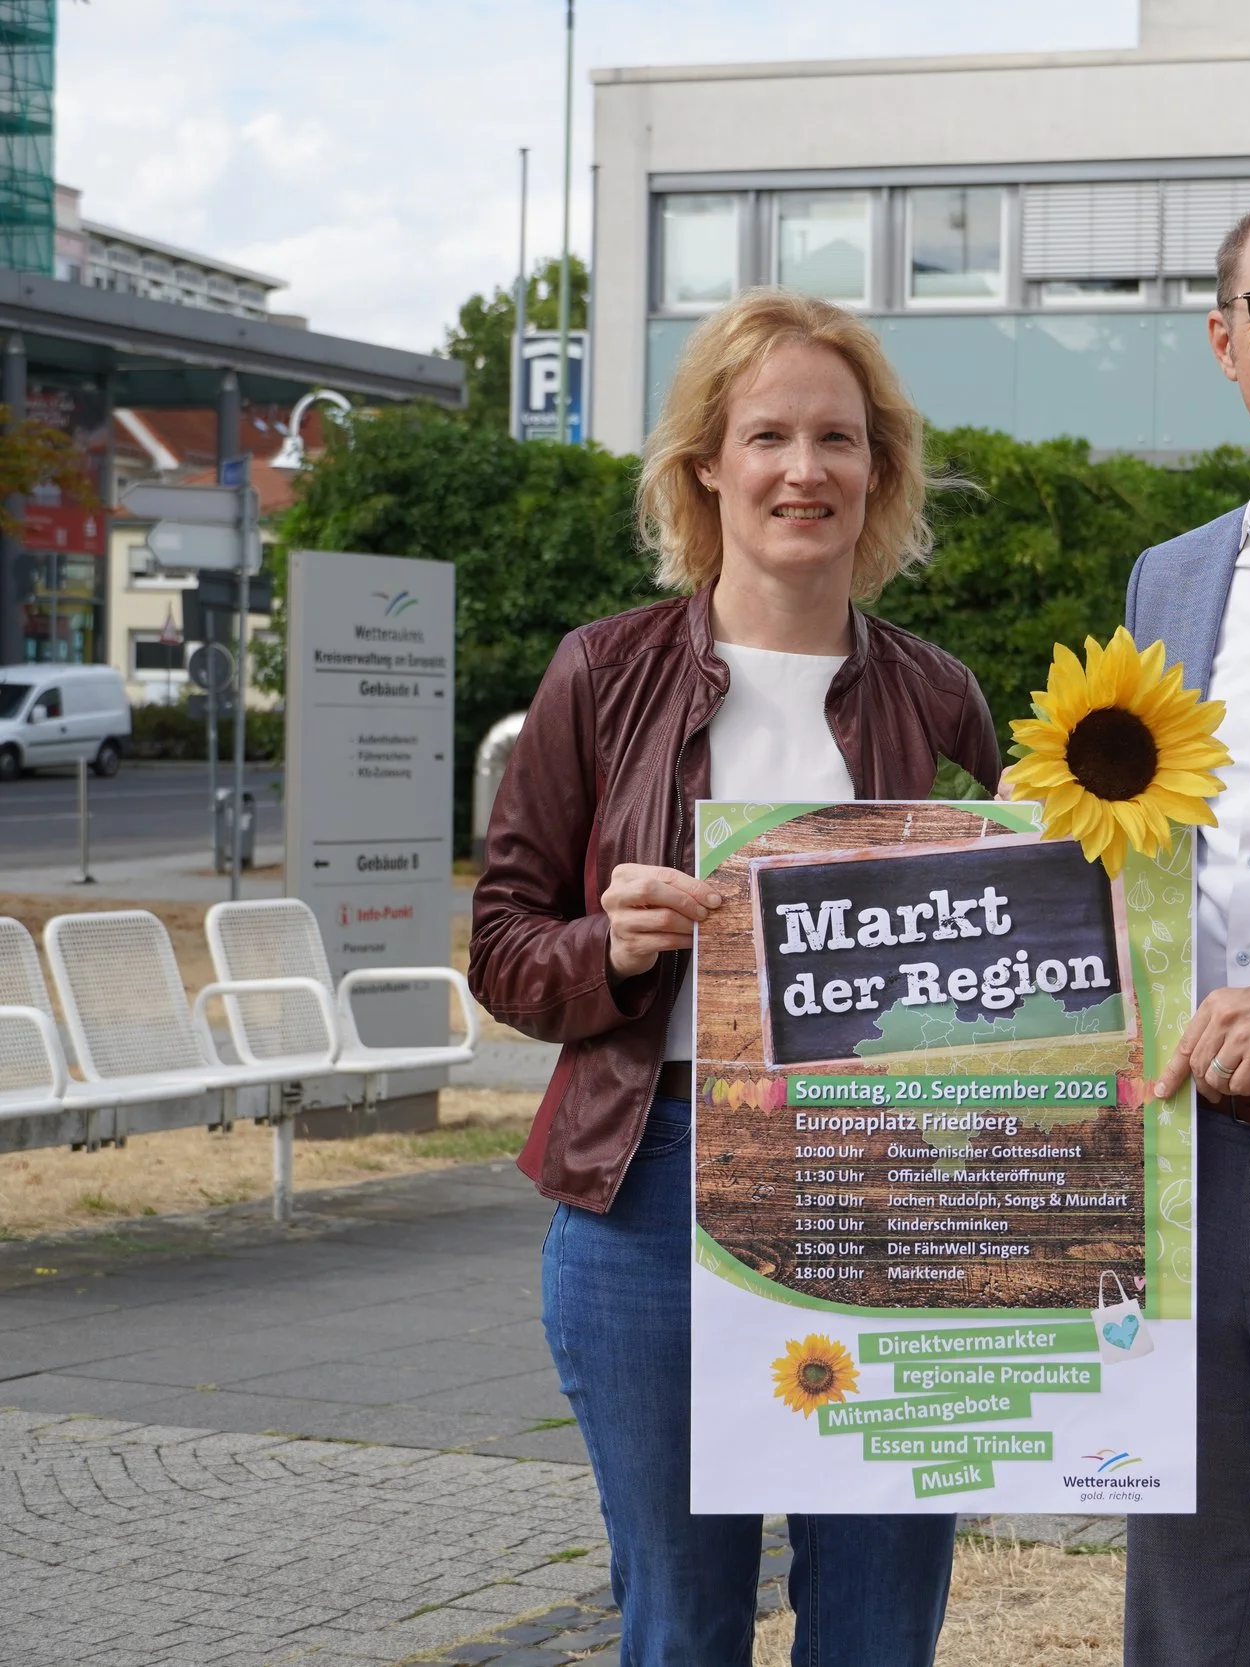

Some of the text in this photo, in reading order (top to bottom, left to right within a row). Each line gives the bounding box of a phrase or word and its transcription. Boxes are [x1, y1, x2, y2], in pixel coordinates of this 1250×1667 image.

[357, 856, 408, 871] Gebäude
[776, 886, 1011, 954] Markt
[784, 950, 1111, 1016] der Region
[796, 1081, 1107, 1104] Sonntag, 20. September 2026
[796, 1113, 1017, 1136] Europaplatz Friedberg
[796, 1143, 1081, 1159] 10:00 Uhr Ökumenischer Gottesdienst
[796, 1169, 1065, 1186] 11:30 Uhr Offizielle Markteröffnung
[796, 1193, 1127, 1210] 13:00 Uhr Jochen Rudolph, Songs & Mundart
[796, 1218, 1008, 1231] 13:00 Uhr Kinderschminken
[796, 1242, 1029, 1259] 15:00 Uhr Die FährWell Singers
[796, 1266, 964, 1280] 18:00 Uhr Marktende
[879, 1330, 1057, 1356] Direktvermarkter
[903, 1366, 1091, 1389] regionale Produkte
[828, 1395, 1010, 1428] Mitmachangebote
[870, 1437, 1046, 1454] Essen und Trinken
[921, 1466, 982, 1491] Musik
[1063, 1475, 1160, 1489] Wetteraukreis
[1080, 1491, 1143, 1501] gold. richtig.
